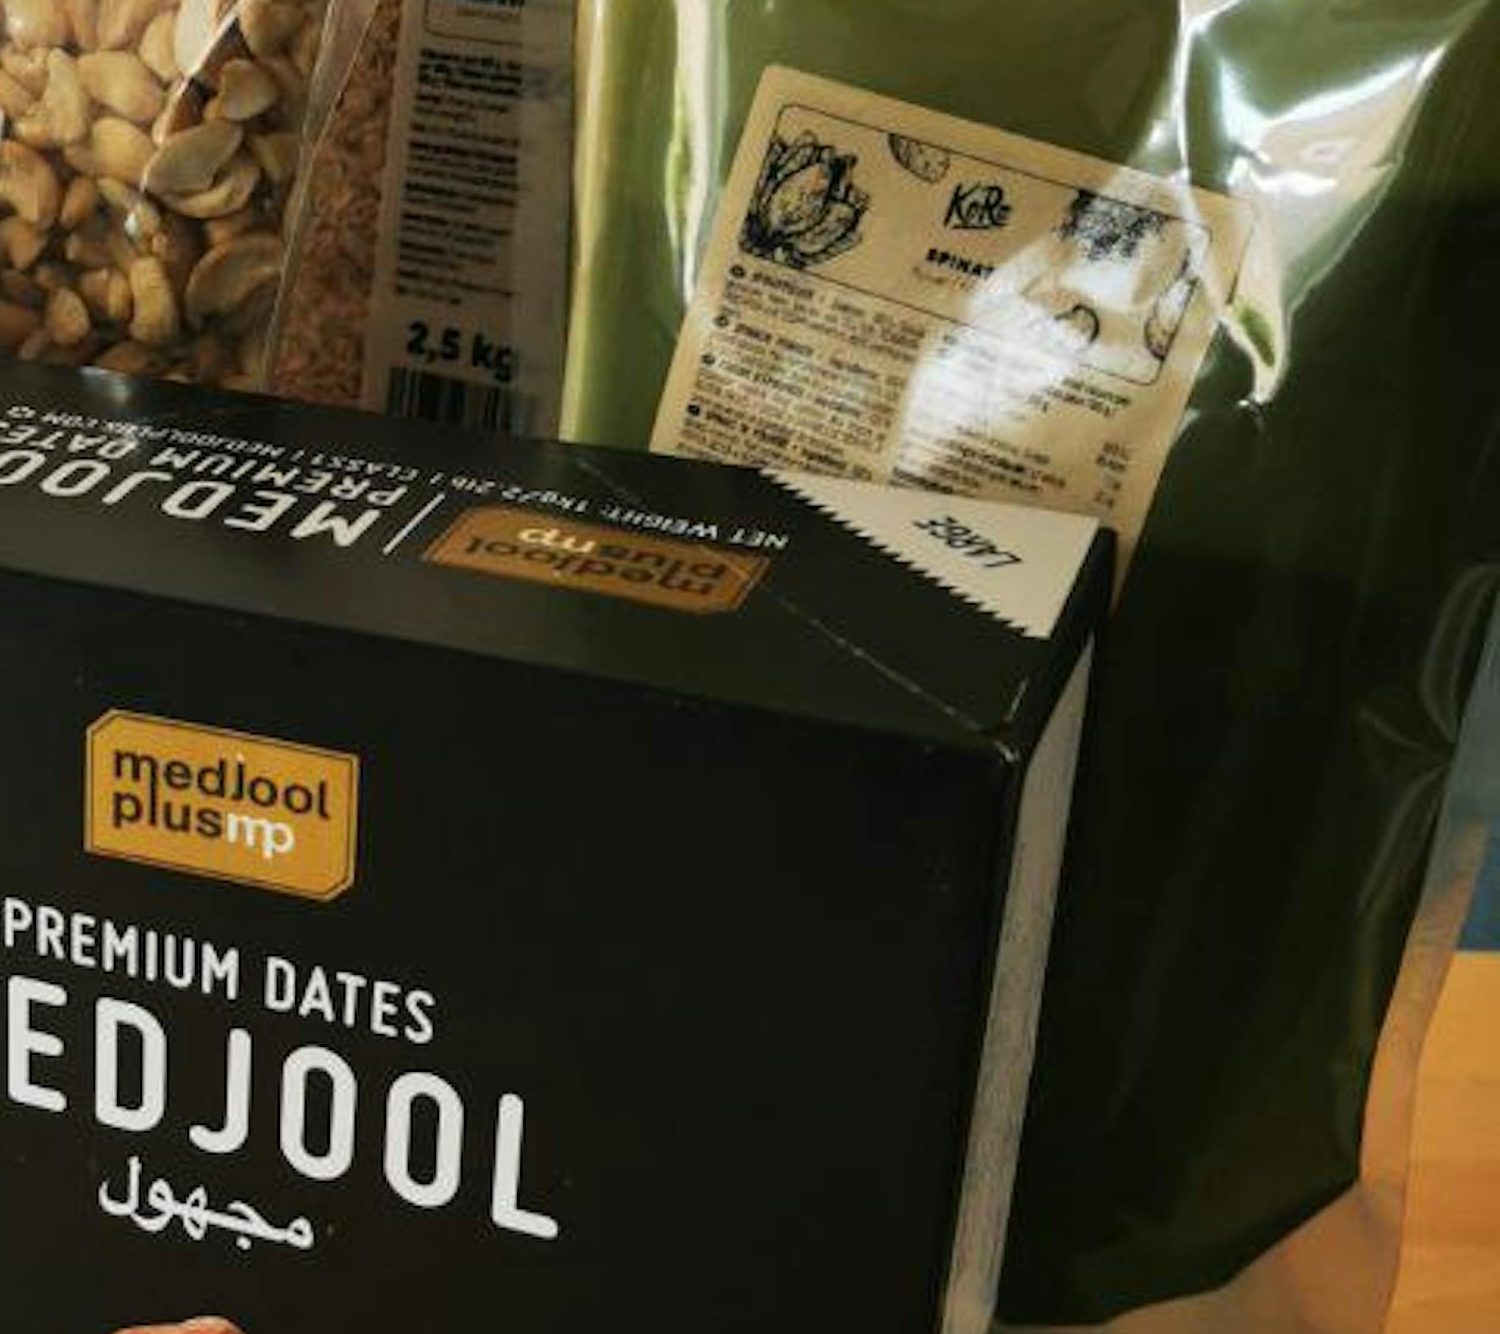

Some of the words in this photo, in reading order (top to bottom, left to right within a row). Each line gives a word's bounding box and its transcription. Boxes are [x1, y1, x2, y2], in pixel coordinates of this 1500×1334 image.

[406, 319, 461, 365] 2,5
[472, 330, 514, 384] kg
[149, 443, 410, 508] PREMIUM
[911, 515, 1026, 569] LARGE
[113, 748, 331, 821] medjool
[4, 896, 241, 1001] PREMIUM
[264, 955, 438, 1045] DATES
[98, 1155, 316, 1252] مجهول
